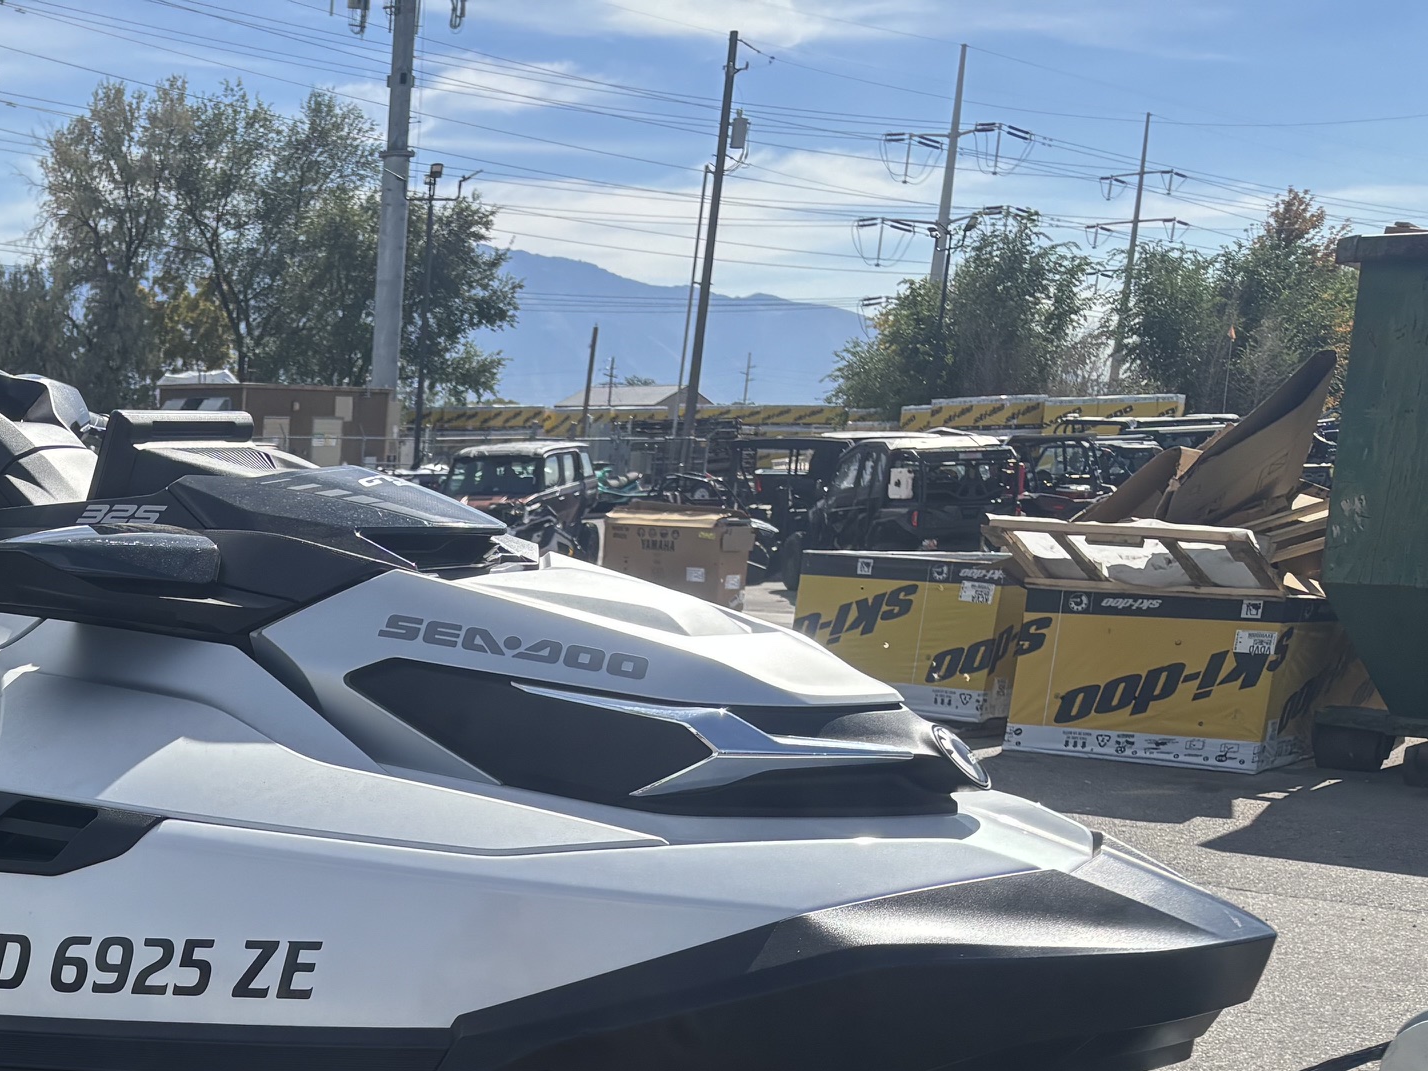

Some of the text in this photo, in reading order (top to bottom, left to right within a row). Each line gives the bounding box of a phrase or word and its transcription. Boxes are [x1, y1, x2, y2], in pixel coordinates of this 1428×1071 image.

[75, 505, 168, 524] 325
[640, 538, 676, 552] YAMAHA
[50, 936, 215, 996] 6925
[231, 940, 324, 1000] ZE
